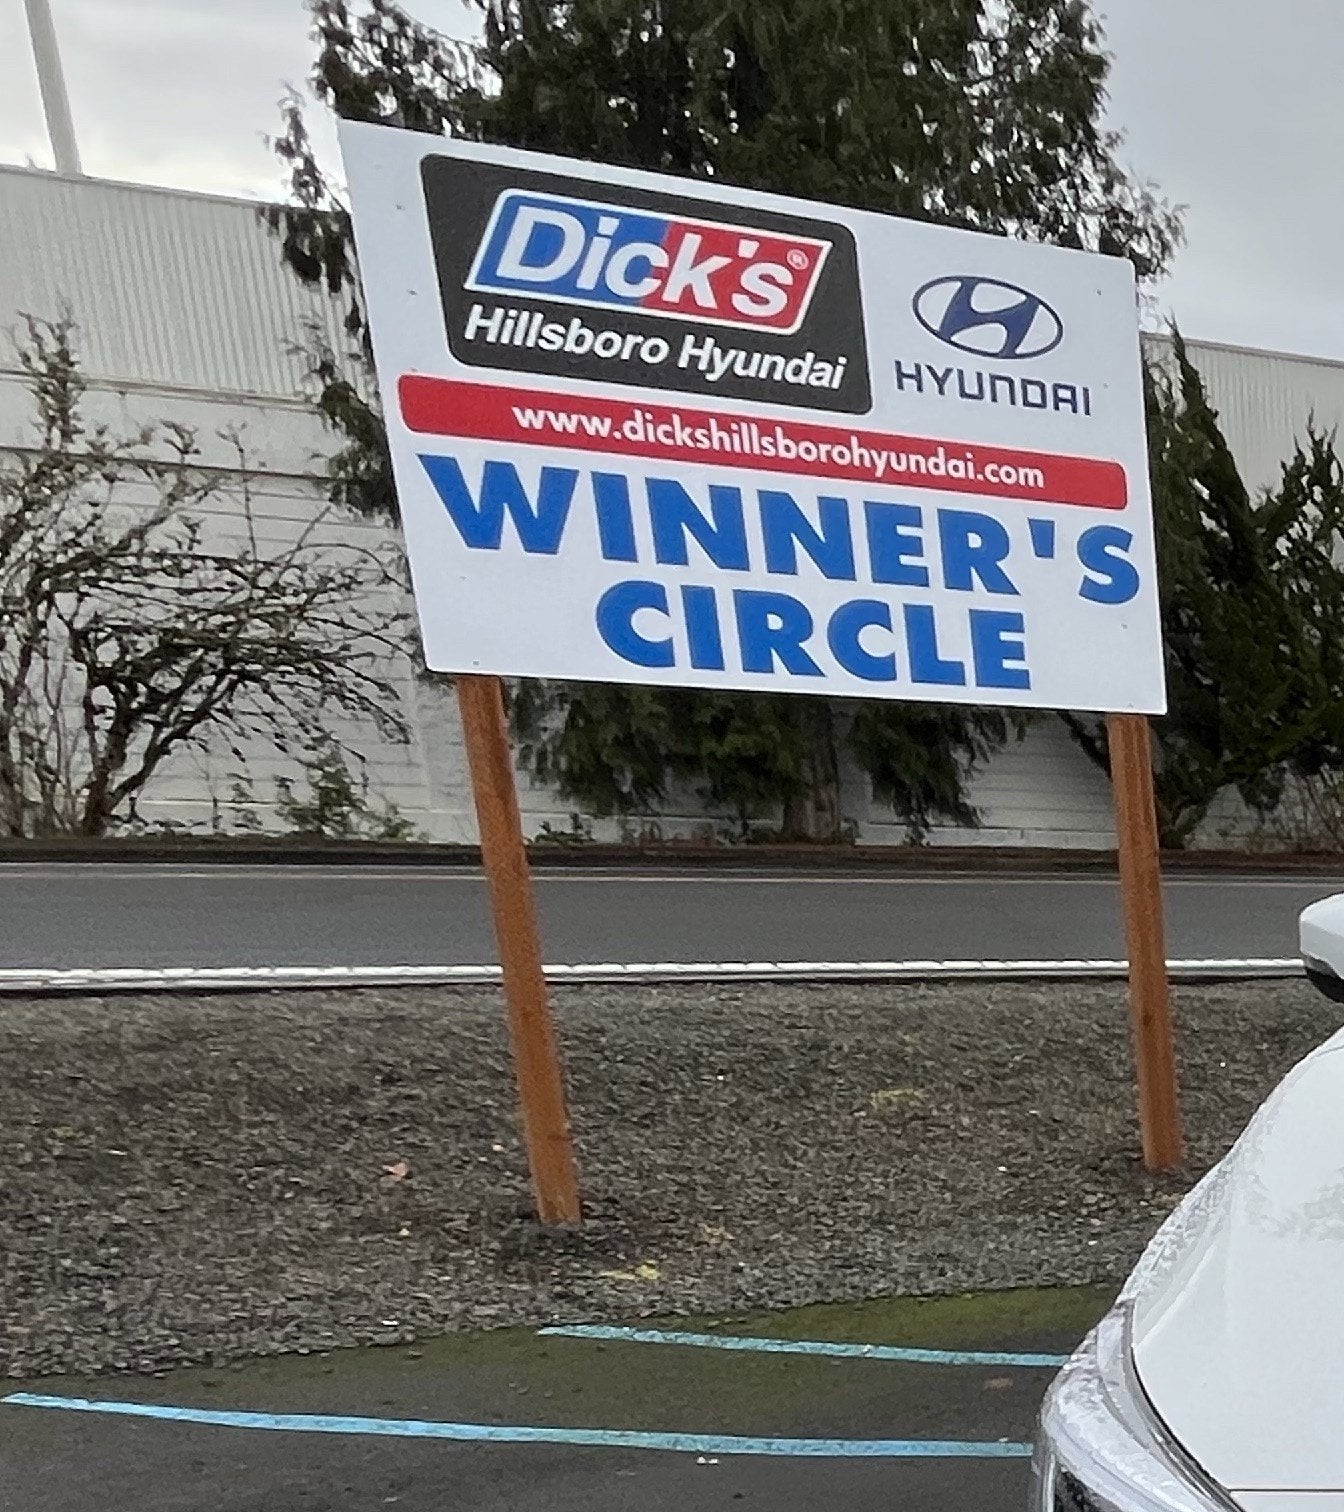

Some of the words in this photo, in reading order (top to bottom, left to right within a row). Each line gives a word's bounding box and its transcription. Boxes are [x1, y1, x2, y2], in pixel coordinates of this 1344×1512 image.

[495, 206, 793, 318] Dick's
[464, 304, 670, 365] Hillsboro
[677, 334, 847, 391] Hyundai
[894, 360, 1091, 415] HYUNDAI
[511, 406, 1045, 488] www.dickshillsborohyundai.com
[417, 453, 1140, 604] WINNER'S
[596, 580, 1031, 690] CIRCLE
